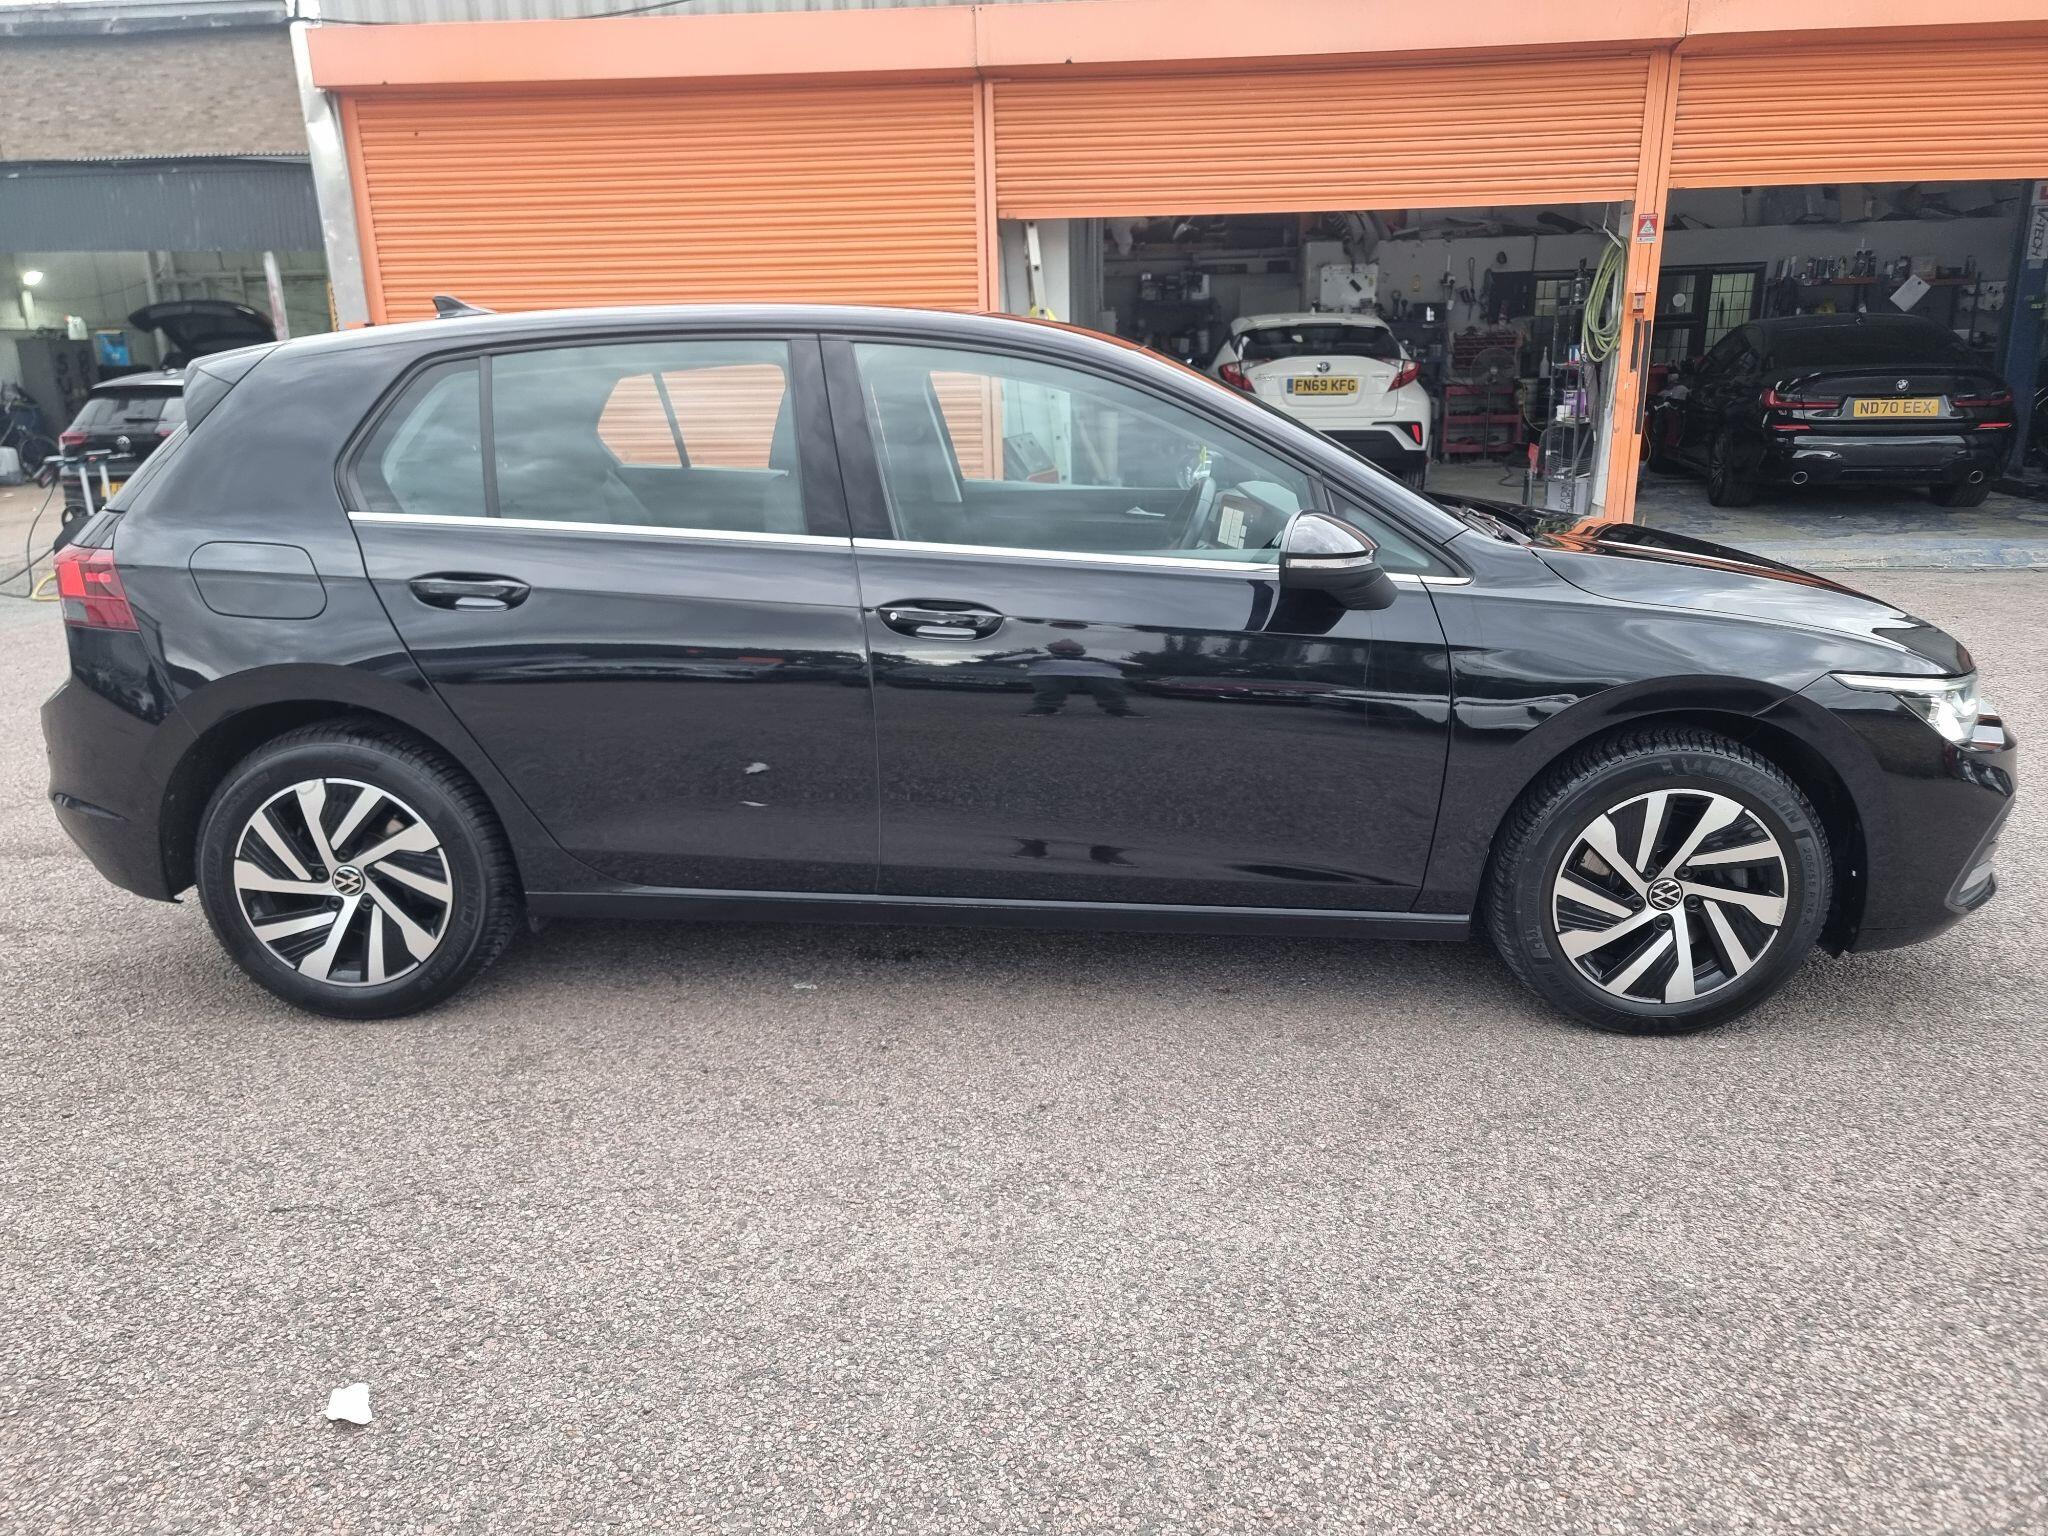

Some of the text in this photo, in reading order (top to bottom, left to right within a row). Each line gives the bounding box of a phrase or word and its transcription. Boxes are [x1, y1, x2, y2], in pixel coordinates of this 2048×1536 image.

[1295, 379, 1355, 391] FN69 KFG
[1860, 401, 1931, 414] ND70 EEX
